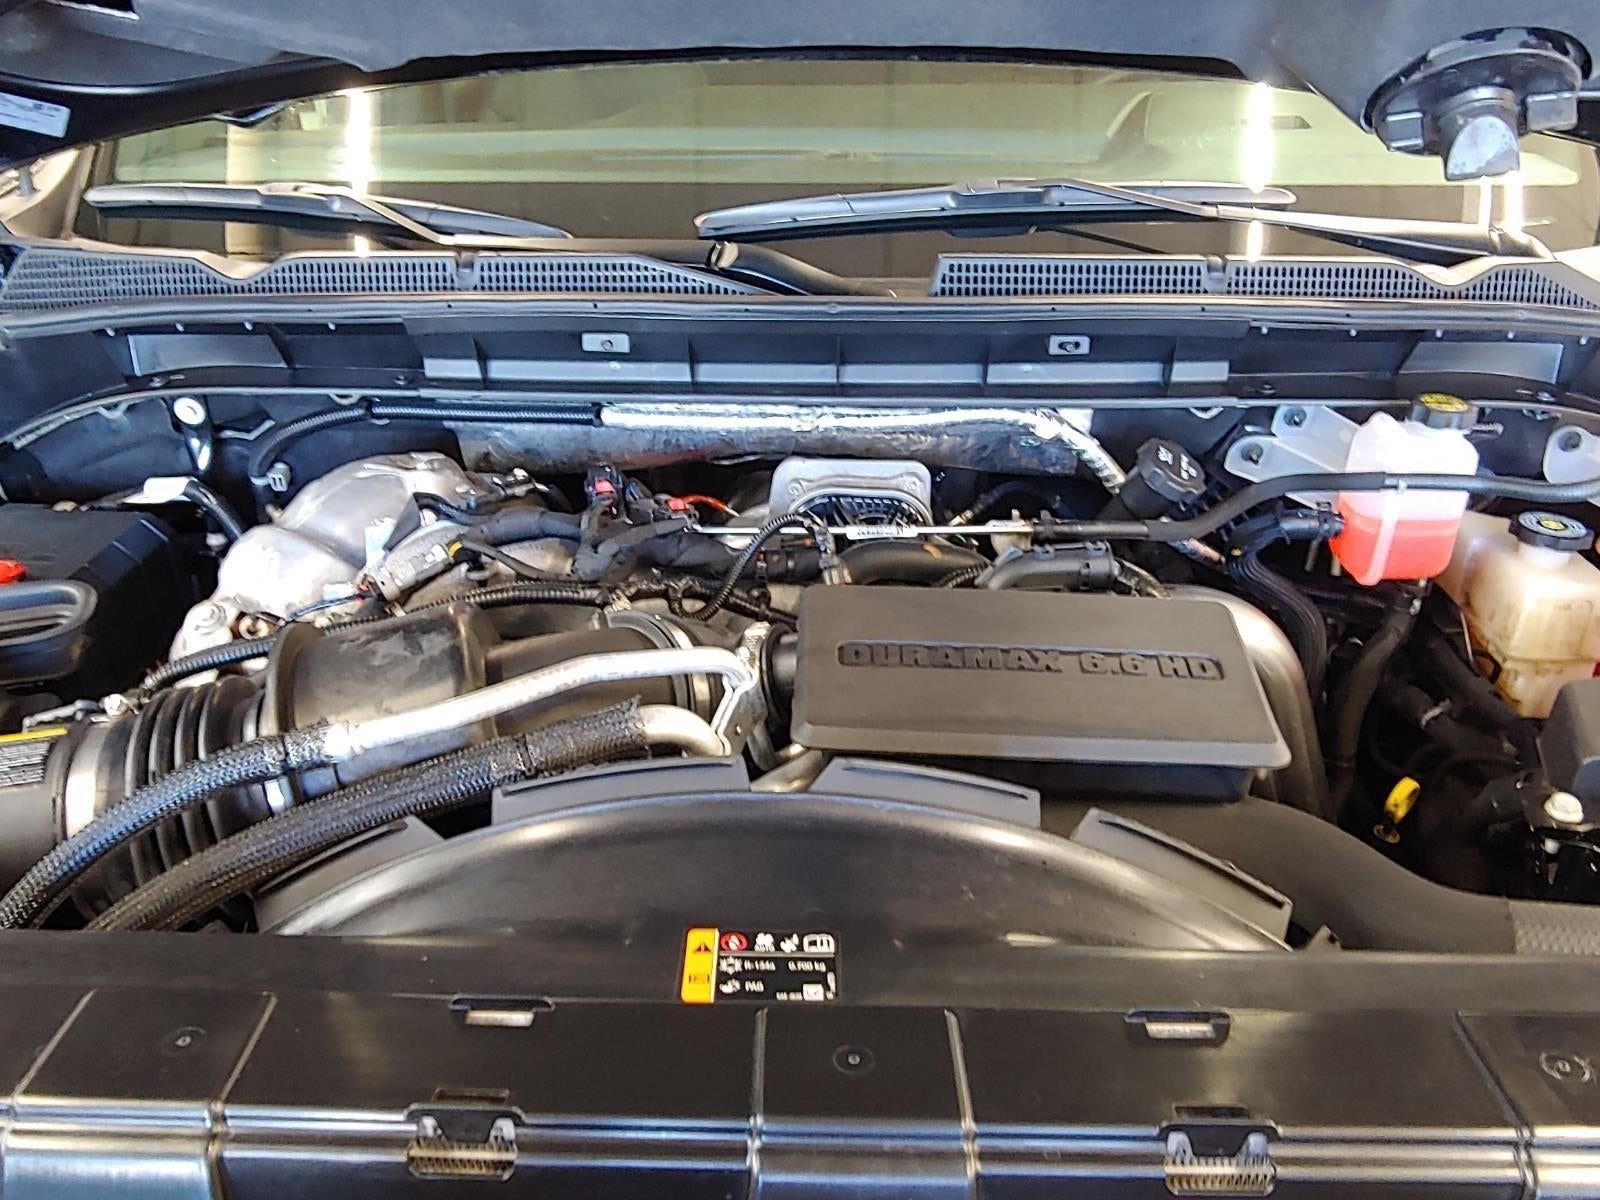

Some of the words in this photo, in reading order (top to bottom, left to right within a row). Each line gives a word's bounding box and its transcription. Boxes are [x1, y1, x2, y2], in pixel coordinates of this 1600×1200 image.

[841, 643, 1063, 673] DURAMAX
[1079, 651, 1148, 676] 6.6
[1156, 655, 1225, 681] HD
